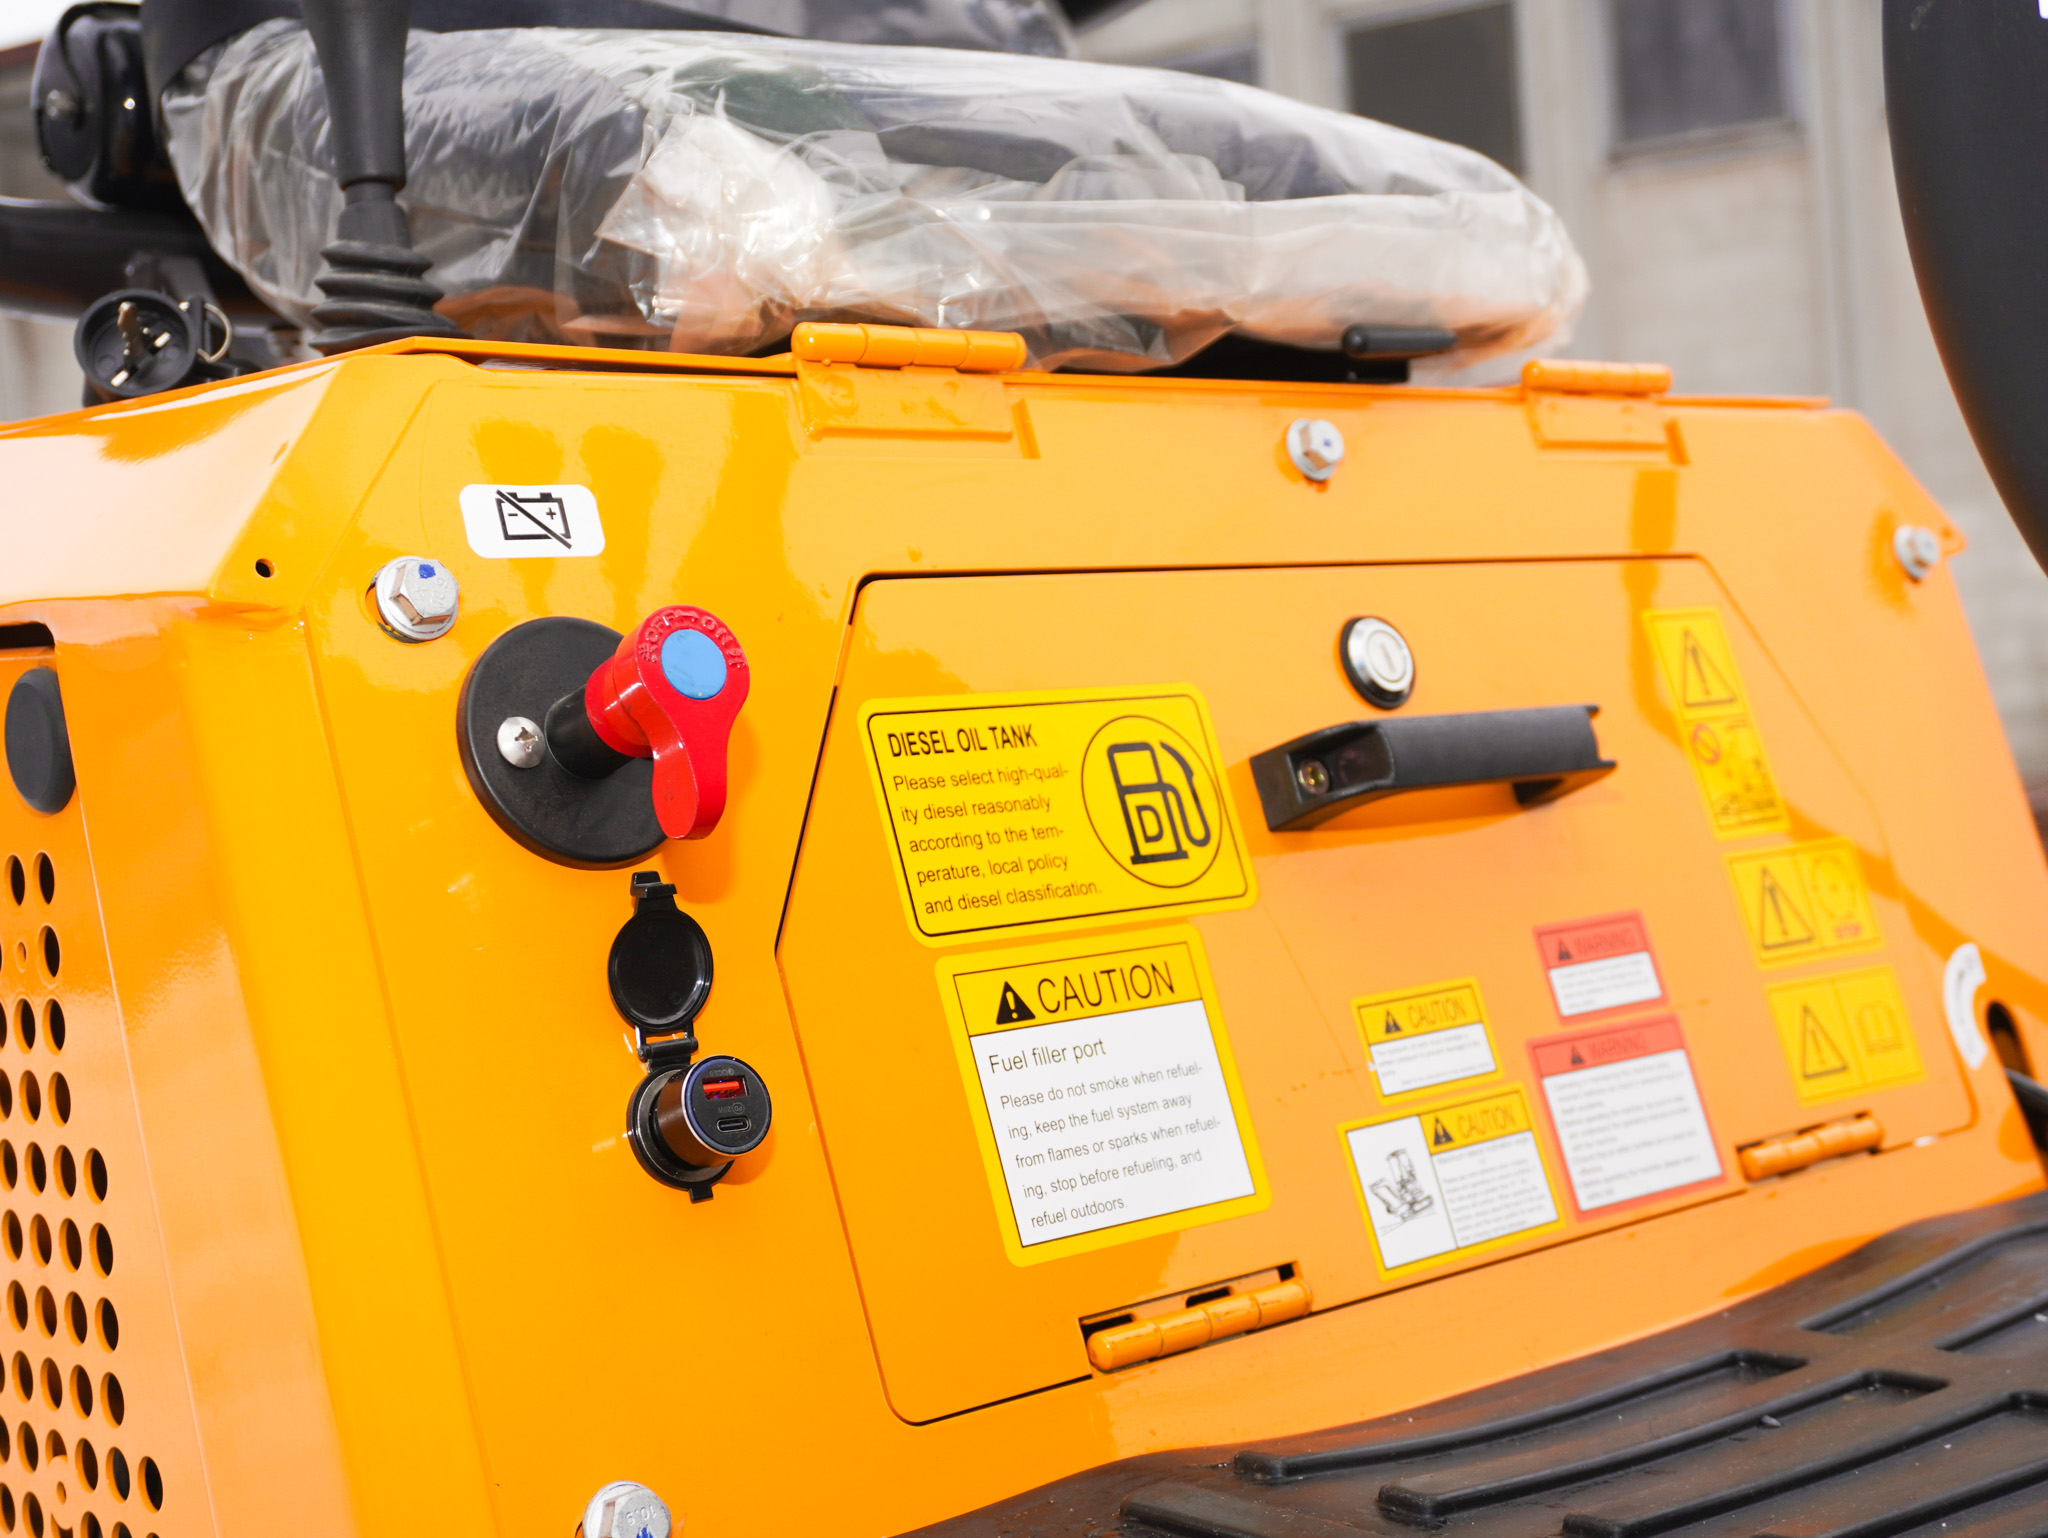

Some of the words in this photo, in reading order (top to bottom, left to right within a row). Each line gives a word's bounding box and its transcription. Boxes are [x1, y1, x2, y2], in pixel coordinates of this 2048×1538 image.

[645, 610, 676, 642] OFF
[702, 616, 733, 645] ON
[888, 729, 954, 757] DIESEL
[958, 727, 986, 752] OIL
[988, 724, 1038, 750] TANK
[893, 773, 946, 791] Please
[949, 769, 994, 788] select
[997, 763, 1069, 788] high-qual-
[901, 806, 918, 824] ity
[923, 801, 968, 819] diesel
[971, 794, 1051, 816] reasonably
[909, 827, 983, 852] according
[986, 831, 1001, 845] to
[1004, 828, 1028, 843] the
[1031, 825, 1064, 840] tem-
[917, 864, 985, 887] perature,
[988, 857, 1023, 876] local
[1027, 854, 1068, 879] policy
[925, 897, 953, 914] and
[958, 890, 1002, 911] diesel
[1005, 881, 1101, 905] classification.
[1572, 927, 1634, 954] WARNING
[1037, 961, 1175, 1013] CAUTION
[1408, 995, 1468, 1029] CAUTION
[989, 1050, 1028, 1074] Fuel
[1032, 1045, 1067, 1066] filler
[1073, 1038, 1106, 1063] port
[1587, 1032, 1648, 1060] WARNING
[1001, 1090, 1044, 1110] Please
[1047, 1086, 1064, 1101] do
[1067, 1083, 1087, 1099] not
[1090, 1076, 1129, 1094] smoke
[1131, 1069, 1164, 1086] when
[1166, 1062, 1202, 1080] refuel-
[1008, 1125, 1032, 1141] ing,
[1035, 1117, 1066, 1137] keep
[1068, 1113, 1089, 1129] the
[1091, 1108, 1114, 1124] fuel
[1117, 1100, 1159, 1120] system
[1162, 1094, 1192, 1113] away
[1457, 1104, 1516, 1138] CAUTION
[1016, 1153, 1045, 1169] from
[1048, 1145, 1089, 1162] flames
[1092, 1141, 1105, 1153] or
[1108, 1131, 1148, 1151] sparks
[1151, 1124, 1183, 1141] when
[1185, 1116, 1221, 1134] refuel-
[1023, 1183, 1047, 1200] ing,
[1050, 1174, 1077, 1193] stop
[1080, 1166, 1120, 1186] before
[1122, 1153, 1177, 1177] refueling,
[1180, 1149, 1202, 1164] and
[1031, 1211, 1068, 1229] refuel
[1070, 1197, 1128, 1219] outdoors.
